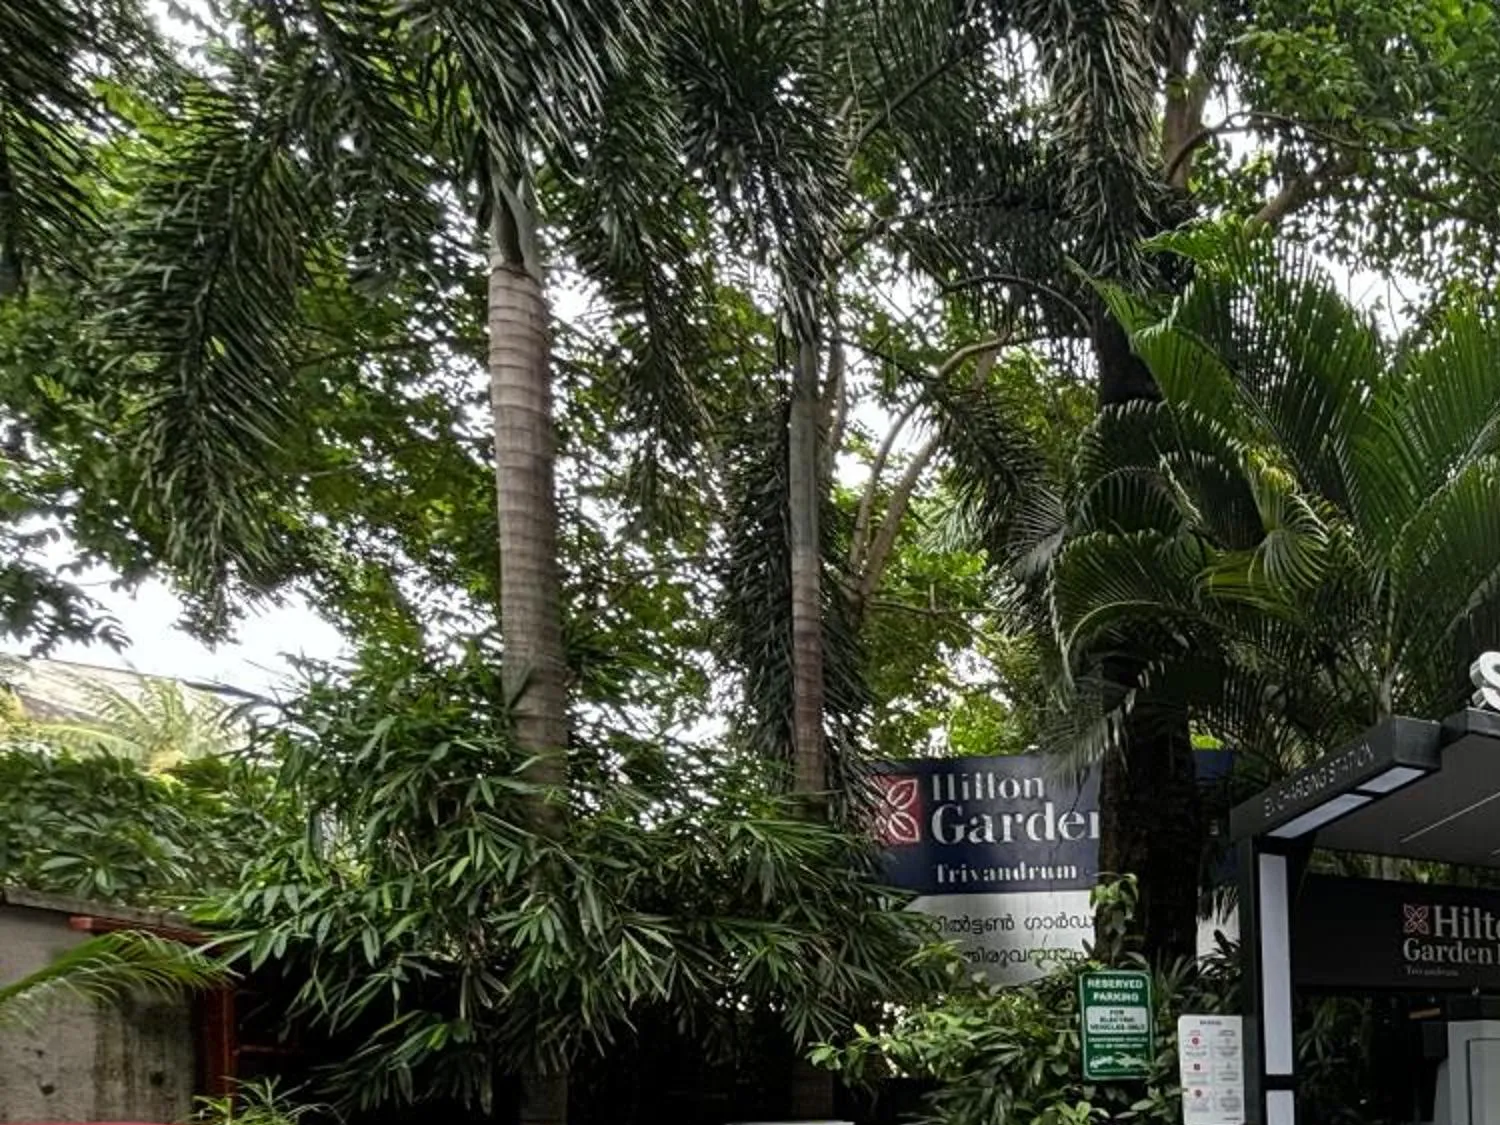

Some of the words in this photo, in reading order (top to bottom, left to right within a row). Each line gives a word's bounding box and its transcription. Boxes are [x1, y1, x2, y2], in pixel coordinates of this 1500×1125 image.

[932, 773, 1045, 801] Hilton
[935, 862, 1078, 884] Trivandrum
[1403, 938, 1493, 964] Garden
[1087, 979, 1144, 989] RESERVED
[1093, 991, 1139, 1002] PARKING
